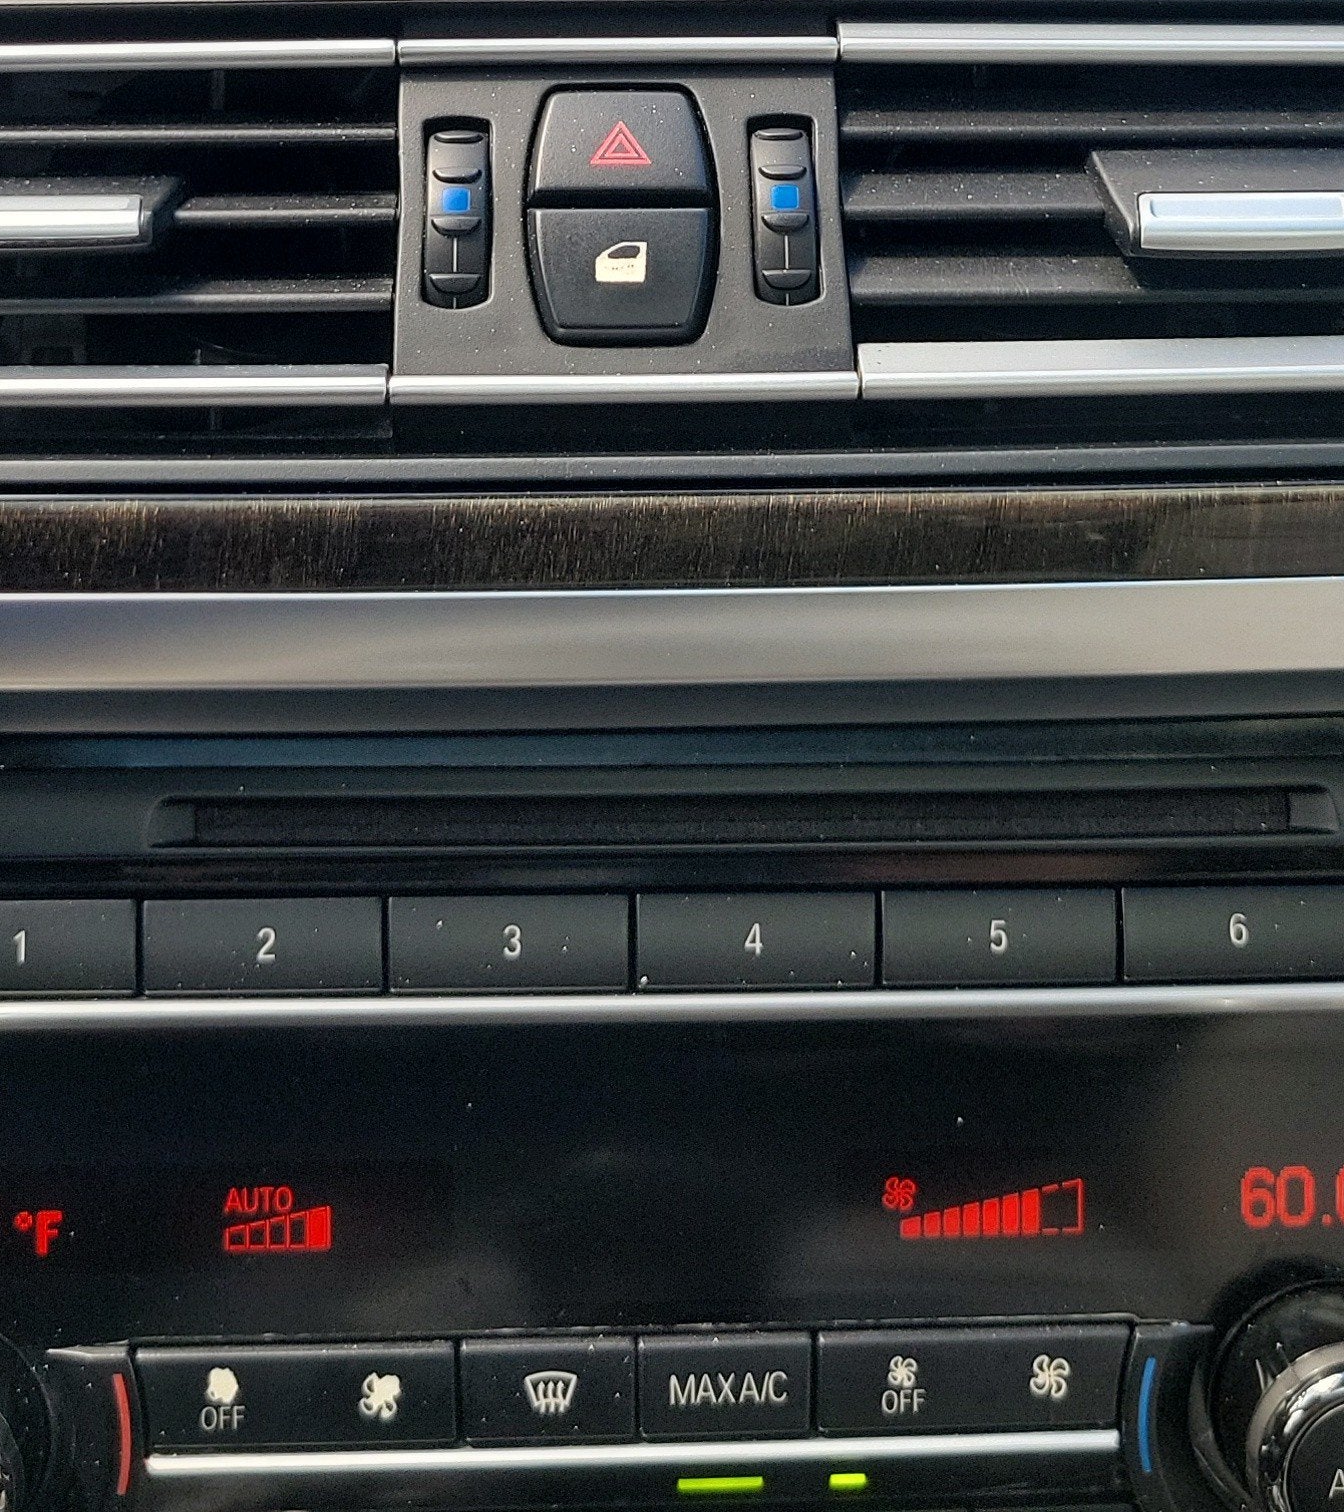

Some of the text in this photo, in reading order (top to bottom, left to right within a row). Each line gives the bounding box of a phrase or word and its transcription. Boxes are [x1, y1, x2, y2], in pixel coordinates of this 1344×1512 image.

[13, 929, 27, 964] 1
[256, 927, 277, 963] 2
[502, 925, 522, 959] 3
[744, 923, 764, 956] 4
[989, 919, 1009, 953] 5
[1228, 913, 1249, 946] 6
[223, 1187, 294, 1214] AUTO
[14, 1209, 63, 1256] °F
[669, 1370, 788, 1407] MAX A/C
[881, 1389, 926, 1415] OFF
[200, 1405, 246, 1431] OFF
